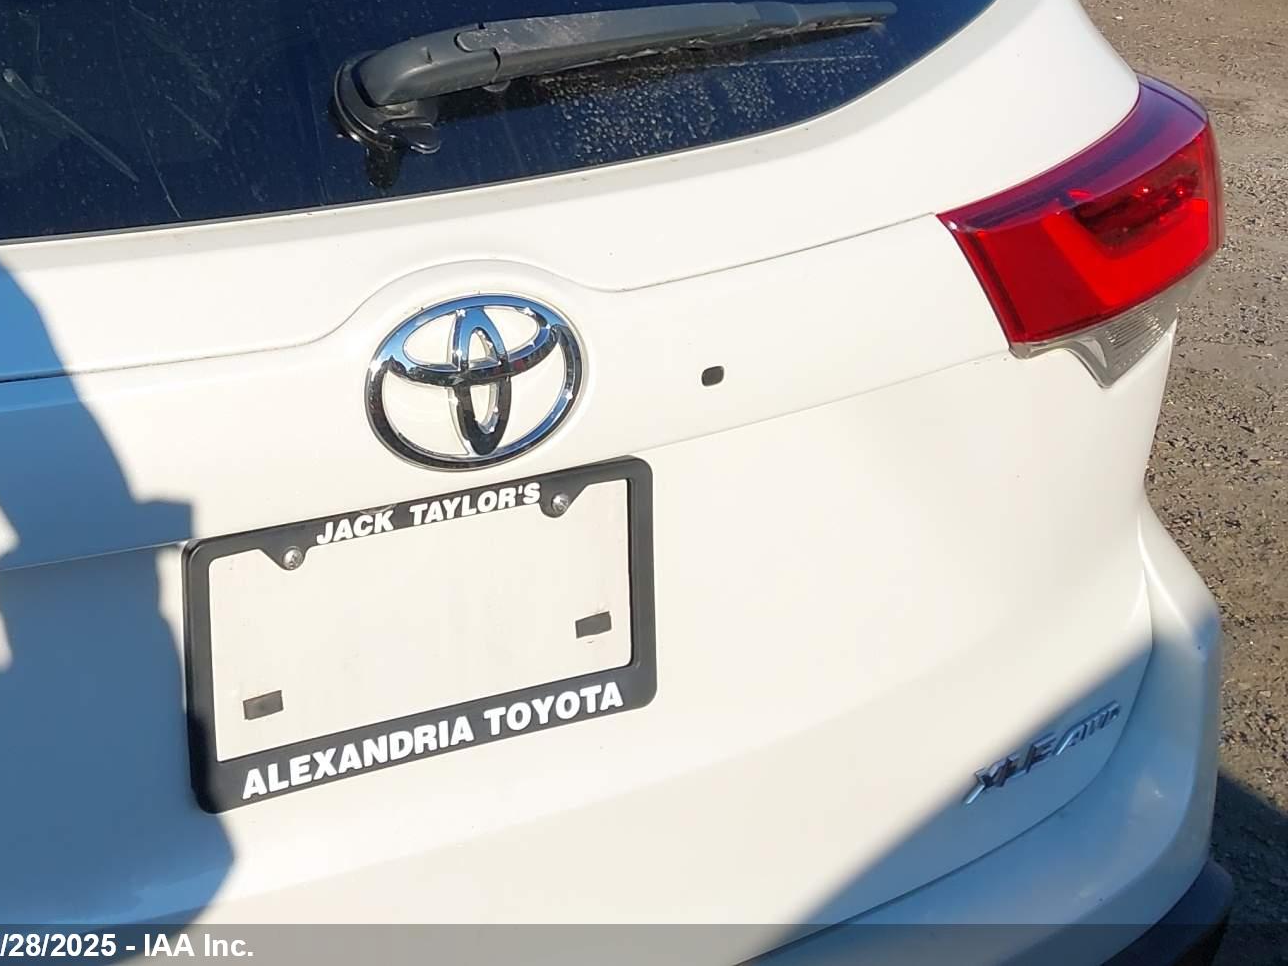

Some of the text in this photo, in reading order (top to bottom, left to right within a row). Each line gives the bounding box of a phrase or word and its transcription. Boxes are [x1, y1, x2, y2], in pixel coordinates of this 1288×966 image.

[316, 482, 541, 545] JACK TAYLOR'S
[242, 681, 624, 800] ALEXANDRIA TOYOTA
